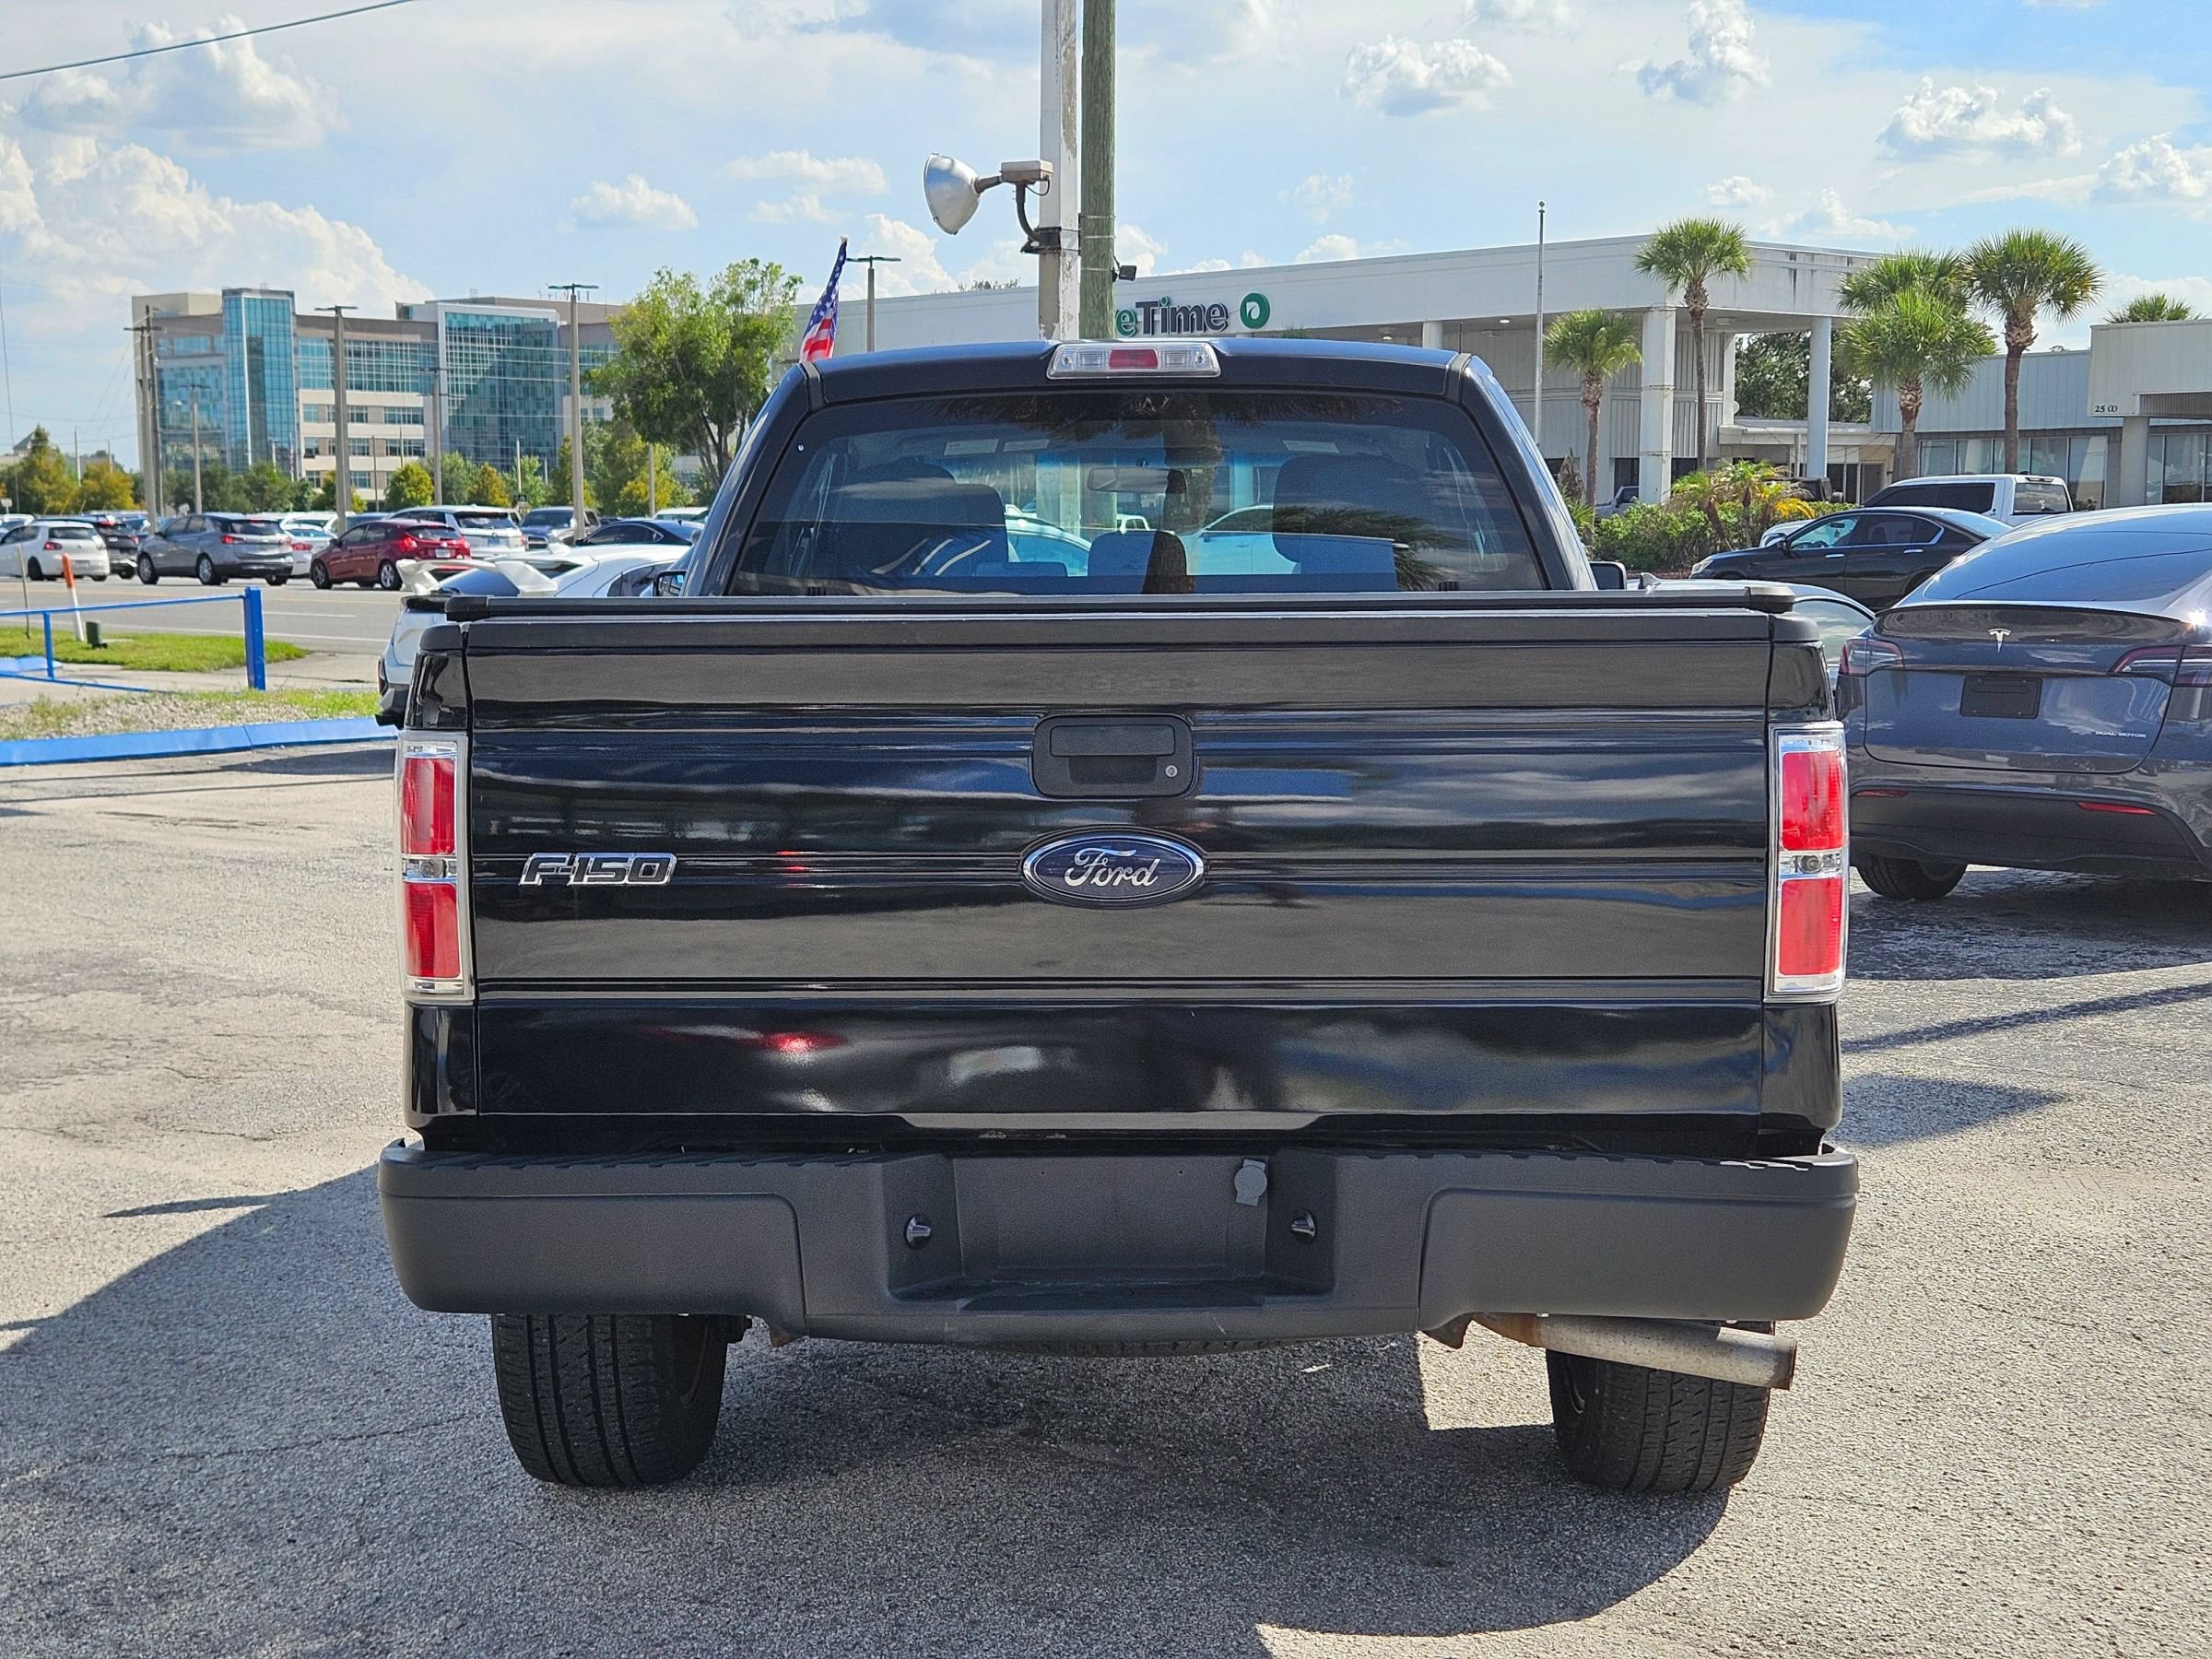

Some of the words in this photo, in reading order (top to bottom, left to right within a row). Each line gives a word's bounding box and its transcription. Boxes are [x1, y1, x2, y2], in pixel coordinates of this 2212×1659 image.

[1115, 296, 1228, 337] eTime
[518, 853, 678, 887] F-150
[1064, 847, 1161, 887] Ford
